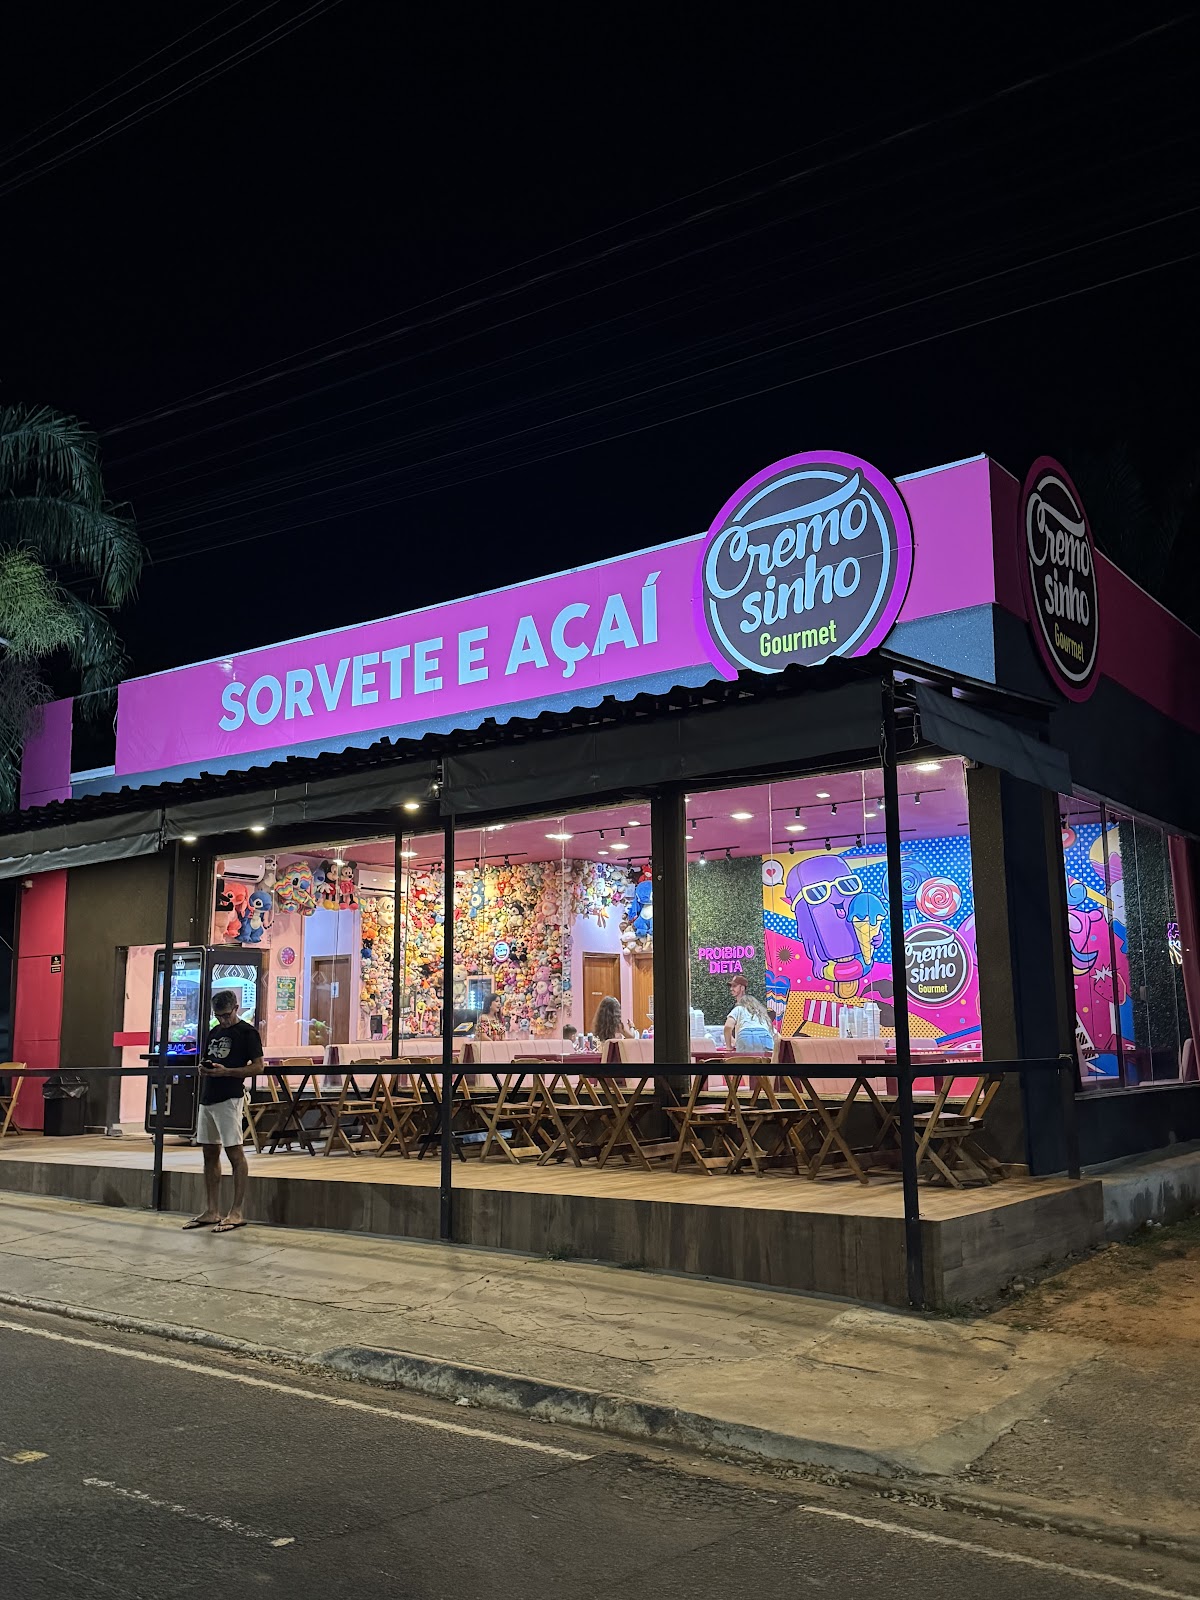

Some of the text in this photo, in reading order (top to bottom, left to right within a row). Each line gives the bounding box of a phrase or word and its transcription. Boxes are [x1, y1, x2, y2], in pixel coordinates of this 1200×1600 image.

[706, 473, 867, 599] Cremo
[1026, 493, 1090, 577] Cremo
[740, 554, 861, 634] sinho
[1045, 568, 1090, 627] sinho
[218, 570, 662, 732] SORVETE E AÇAÍ
[760, 619, 837, 657] Gourmet
[1054, 622, 1085, 664] Gourmet
[910, 959, 956, 984] sinho
[918, 983, 948, 994] Gourmet
